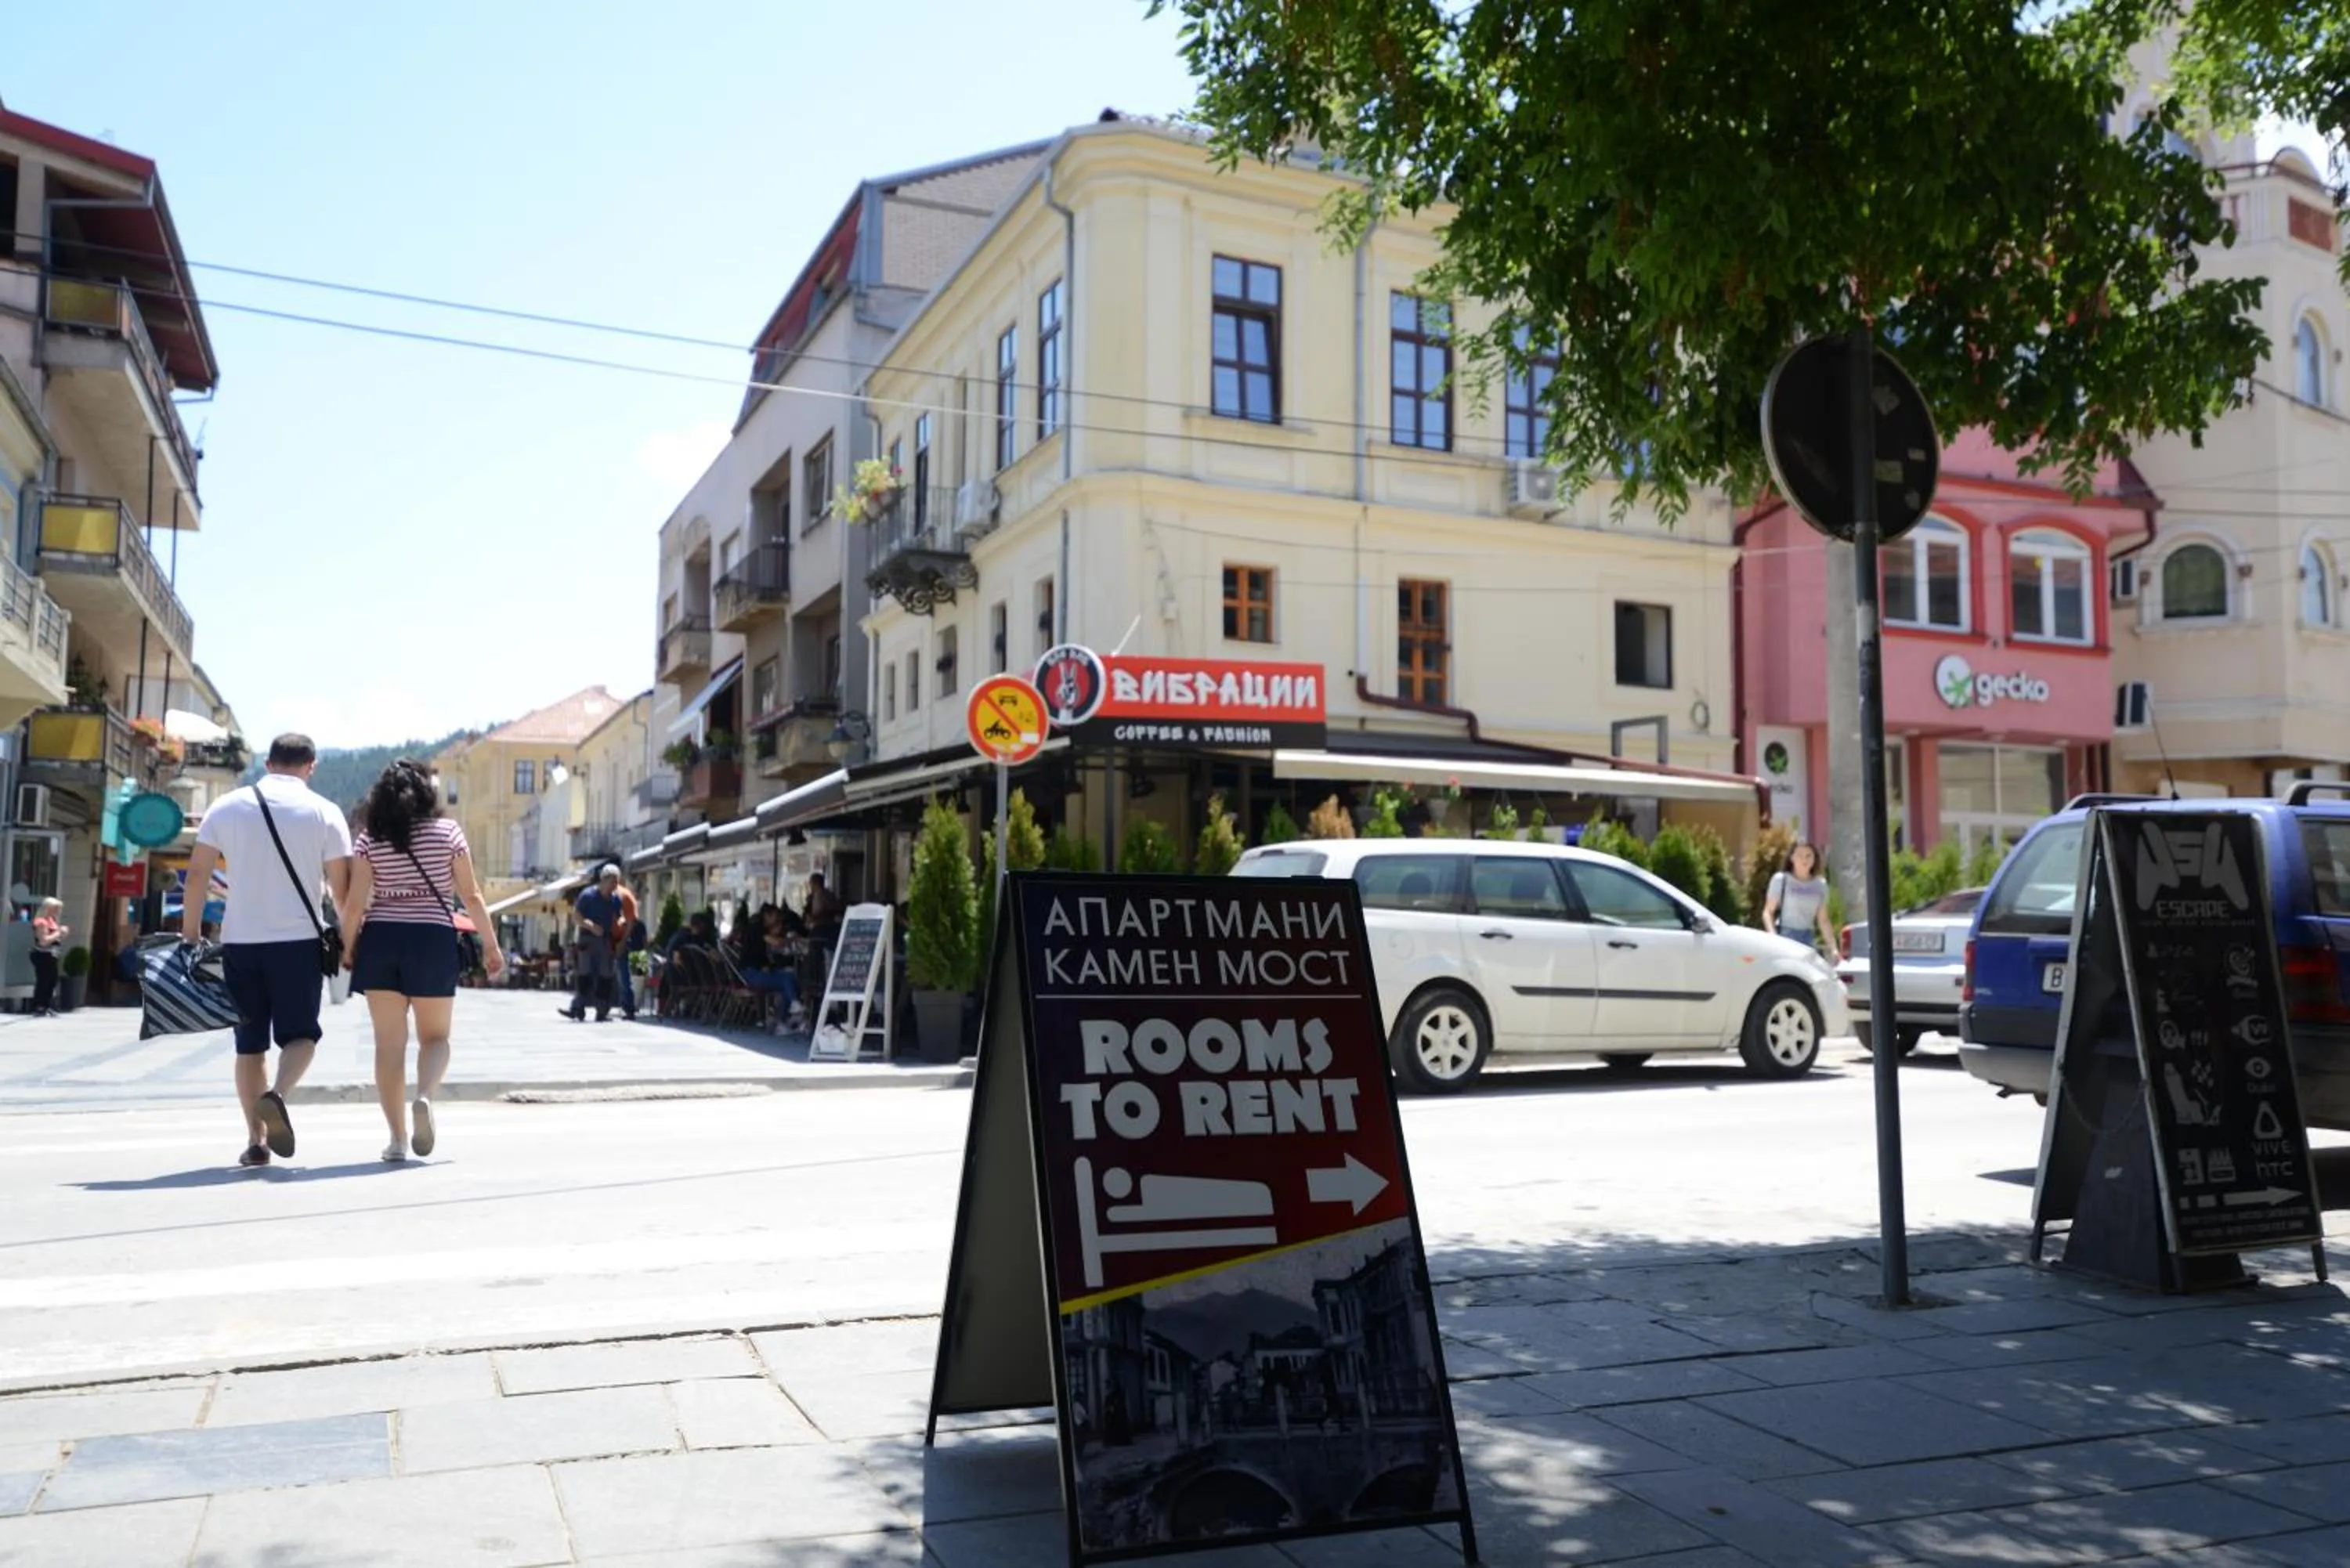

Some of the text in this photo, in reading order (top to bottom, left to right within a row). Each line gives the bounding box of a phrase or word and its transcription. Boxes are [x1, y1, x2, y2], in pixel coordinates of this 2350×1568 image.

[1112, 669, 1318, 708] ВИБРАЦИИ
[1976, 671, 2050, 706] gecko
[1114, 724, 1183, 740] COFFEE
[1043, 897, 1347, 939] АПАРТМАНИ
[2156, 900, 2230, 919] ESCAPE
[1044, 948, 1350, 985] КАМЕН МОСТ
[1080, 1018, 1332, 1075] ROOMS
[1060, 1078, 1359, 1140] TO RENT
[2251, 1140, 2294, 1154] VIVE
